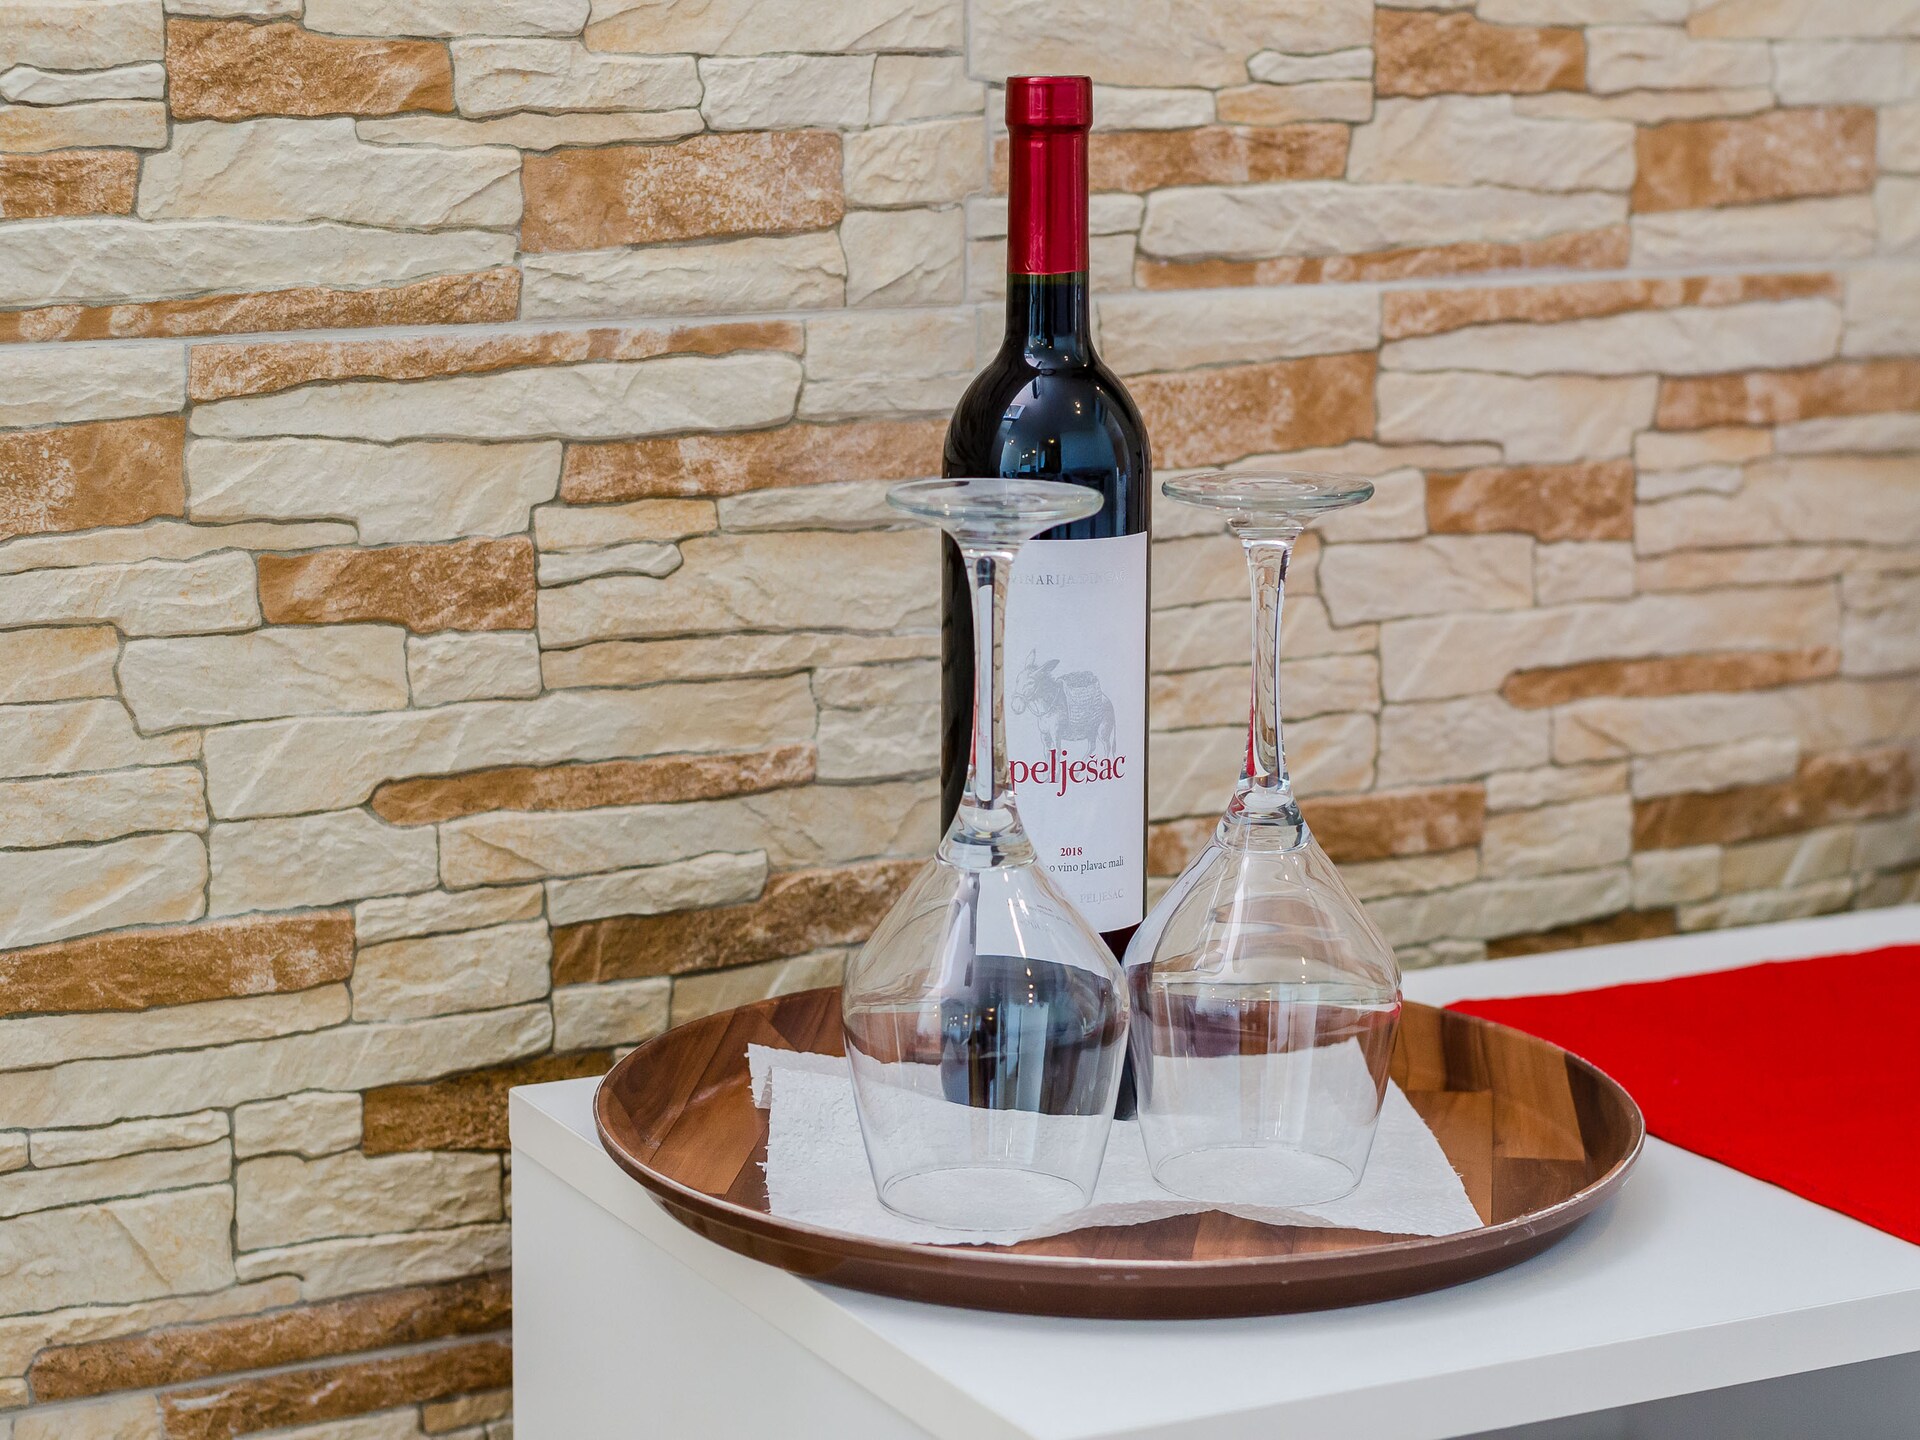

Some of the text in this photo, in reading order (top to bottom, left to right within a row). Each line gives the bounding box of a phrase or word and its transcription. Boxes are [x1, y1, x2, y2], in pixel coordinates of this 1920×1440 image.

[1008, 748, 1127, 797] pelješac
[1060, 846, 1083, 857] 2018
[1057, 863, 1079, 873] vino
[1080, 859, 1108, 875] plavac
[1108, 855, 1124, 868] mali
